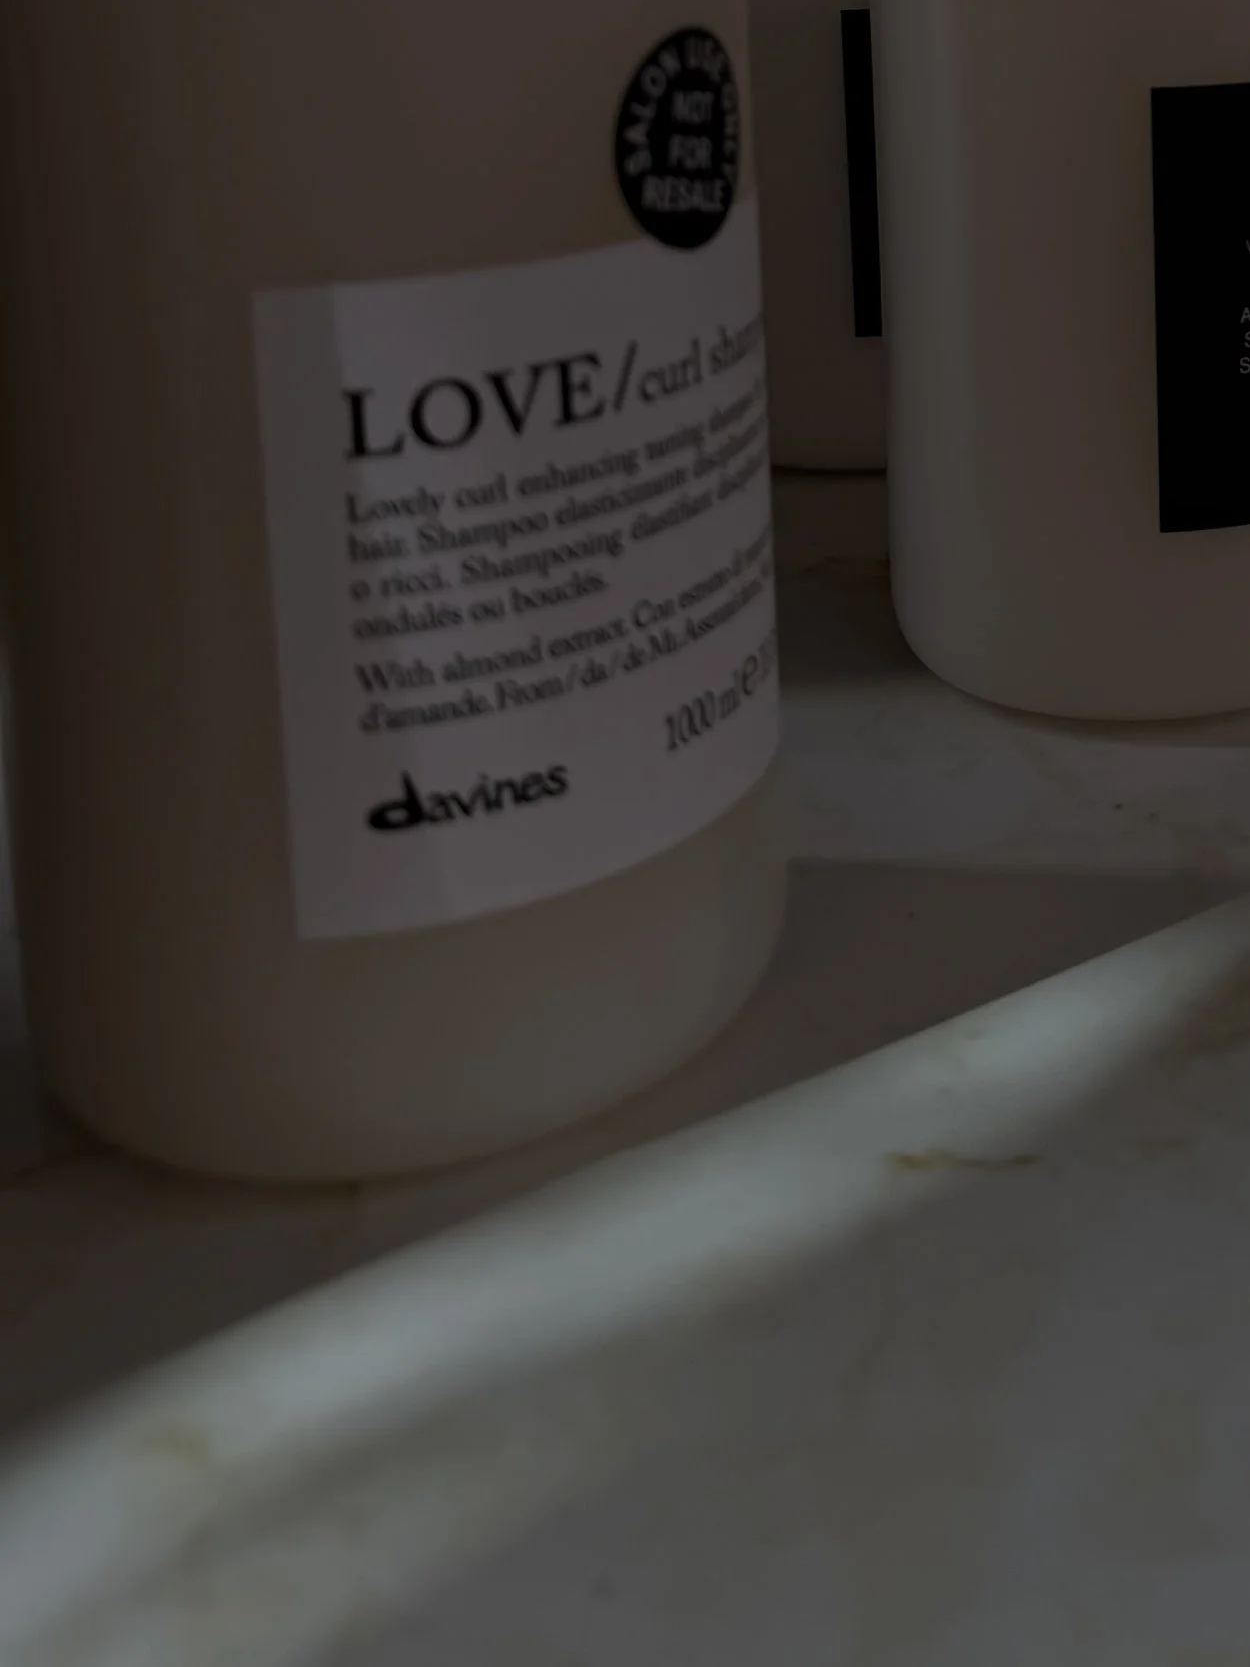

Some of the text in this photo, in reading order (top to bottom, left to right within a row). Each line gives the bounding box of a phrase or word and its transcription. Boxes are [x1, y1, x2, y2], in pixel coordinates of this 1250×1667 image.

[622, 44, 682, 178] SALON
[670, 89, 716, 125] NOT
[666, 133, 713, 171] FOR
[640, 175, 726, 214] RESALE
[345, 486, 444, 526] Lovely
[453, 472, 509, 510] curl
[516, 446, 640, 496] enhancing
[351, 577, 369, 602] o
[379, 564, 451, 599] ricci.
[460, 527, 624, 587] Shampooing
[417, 508, 549, 560] Shampoo
[352, 568, 611, 641] ondulés ou bouclés.
[354, 658, 436, 693] With
[441, 634, 544, 685] almond
[631, 597, 676, 631] Con
[496, 672, 564, 715] From
[663, 689, 717, 754] 1000
[367, 763, 569, 834] davines
